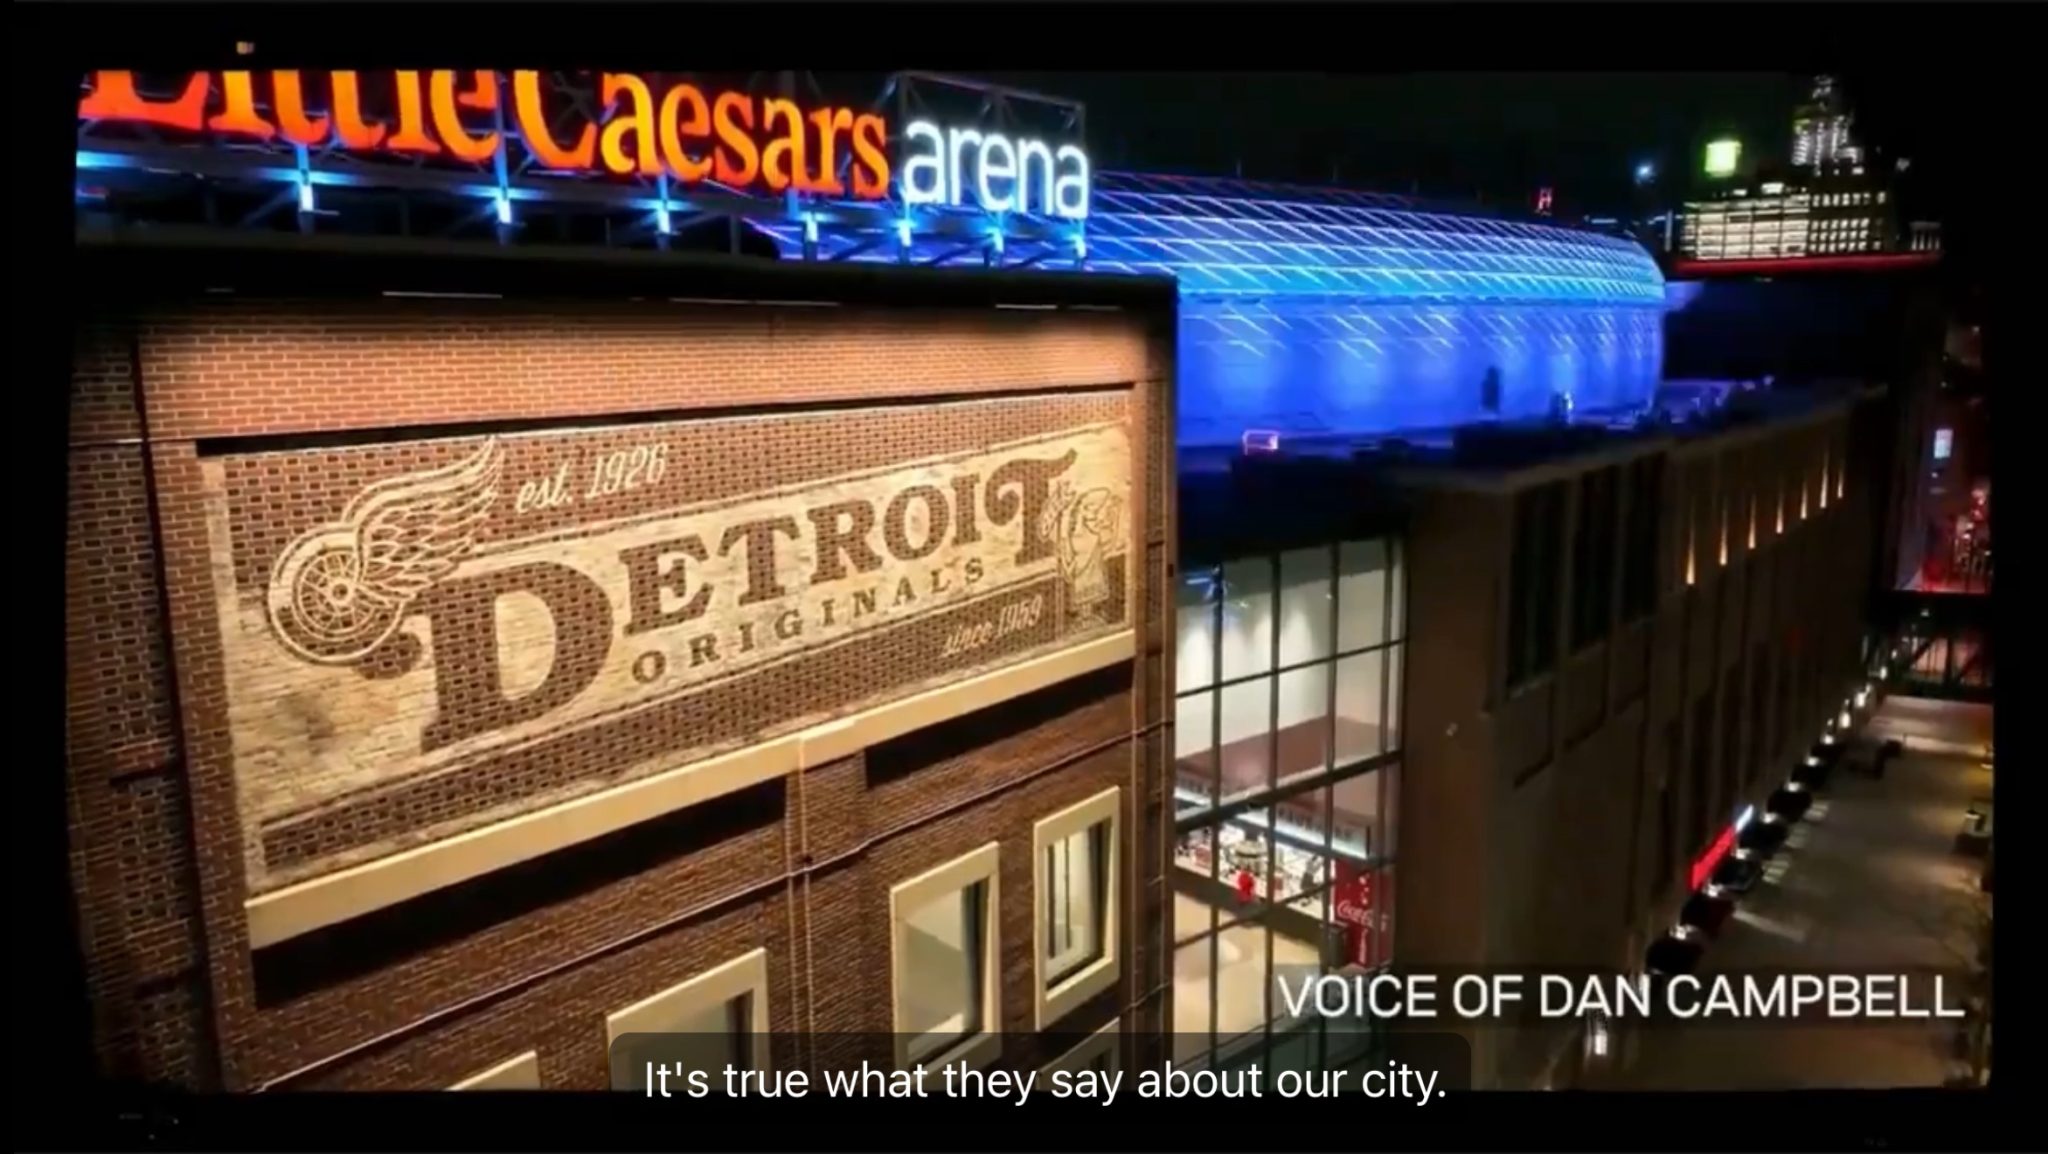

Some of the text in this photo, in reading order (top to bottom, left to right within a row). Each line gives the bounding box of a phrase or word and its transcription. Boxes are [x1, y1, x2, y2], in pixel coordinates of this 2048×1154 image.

[514, 70, 890, 199] Caesars
[904, 119, 1090, 219] arena
[515, 441, 669, 514] est. 1926
[349, 448, 1077, 756] DETROIT
[631, 556, 985, 685] ORIGINALS
[994, 594, 1043, 639] 1959
